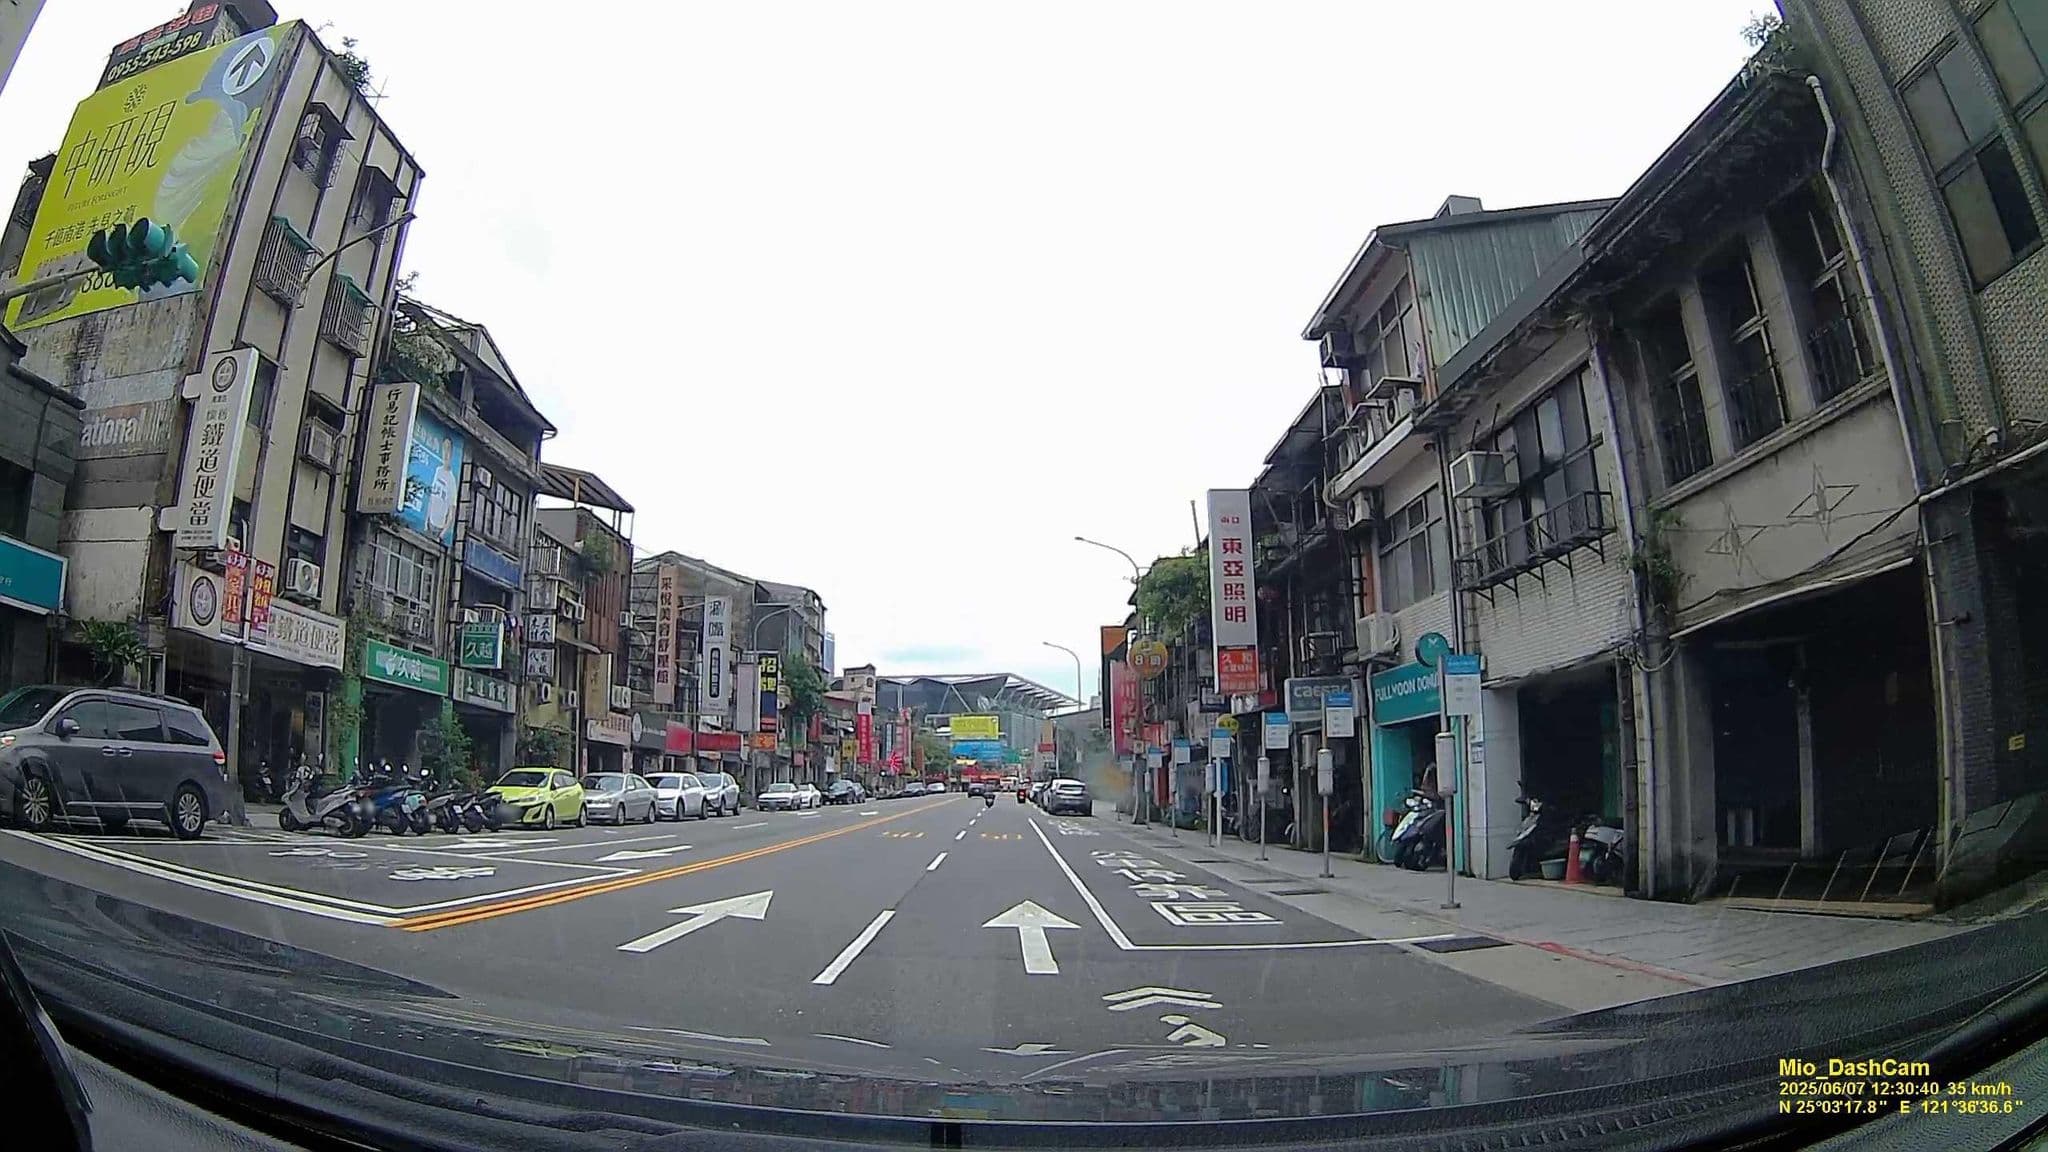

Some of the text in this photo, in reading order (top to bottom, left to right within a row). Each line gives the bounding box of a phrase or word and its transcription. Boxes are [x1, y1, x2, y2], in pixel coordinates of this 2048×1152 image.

[107, 31, 203, 82] 0955-543-598
[63, 100, 177, 200] 中研硯
[189, 422, 225, 527] 鐵道便當
[1221, 537, 1247, 623] 東亞照明
